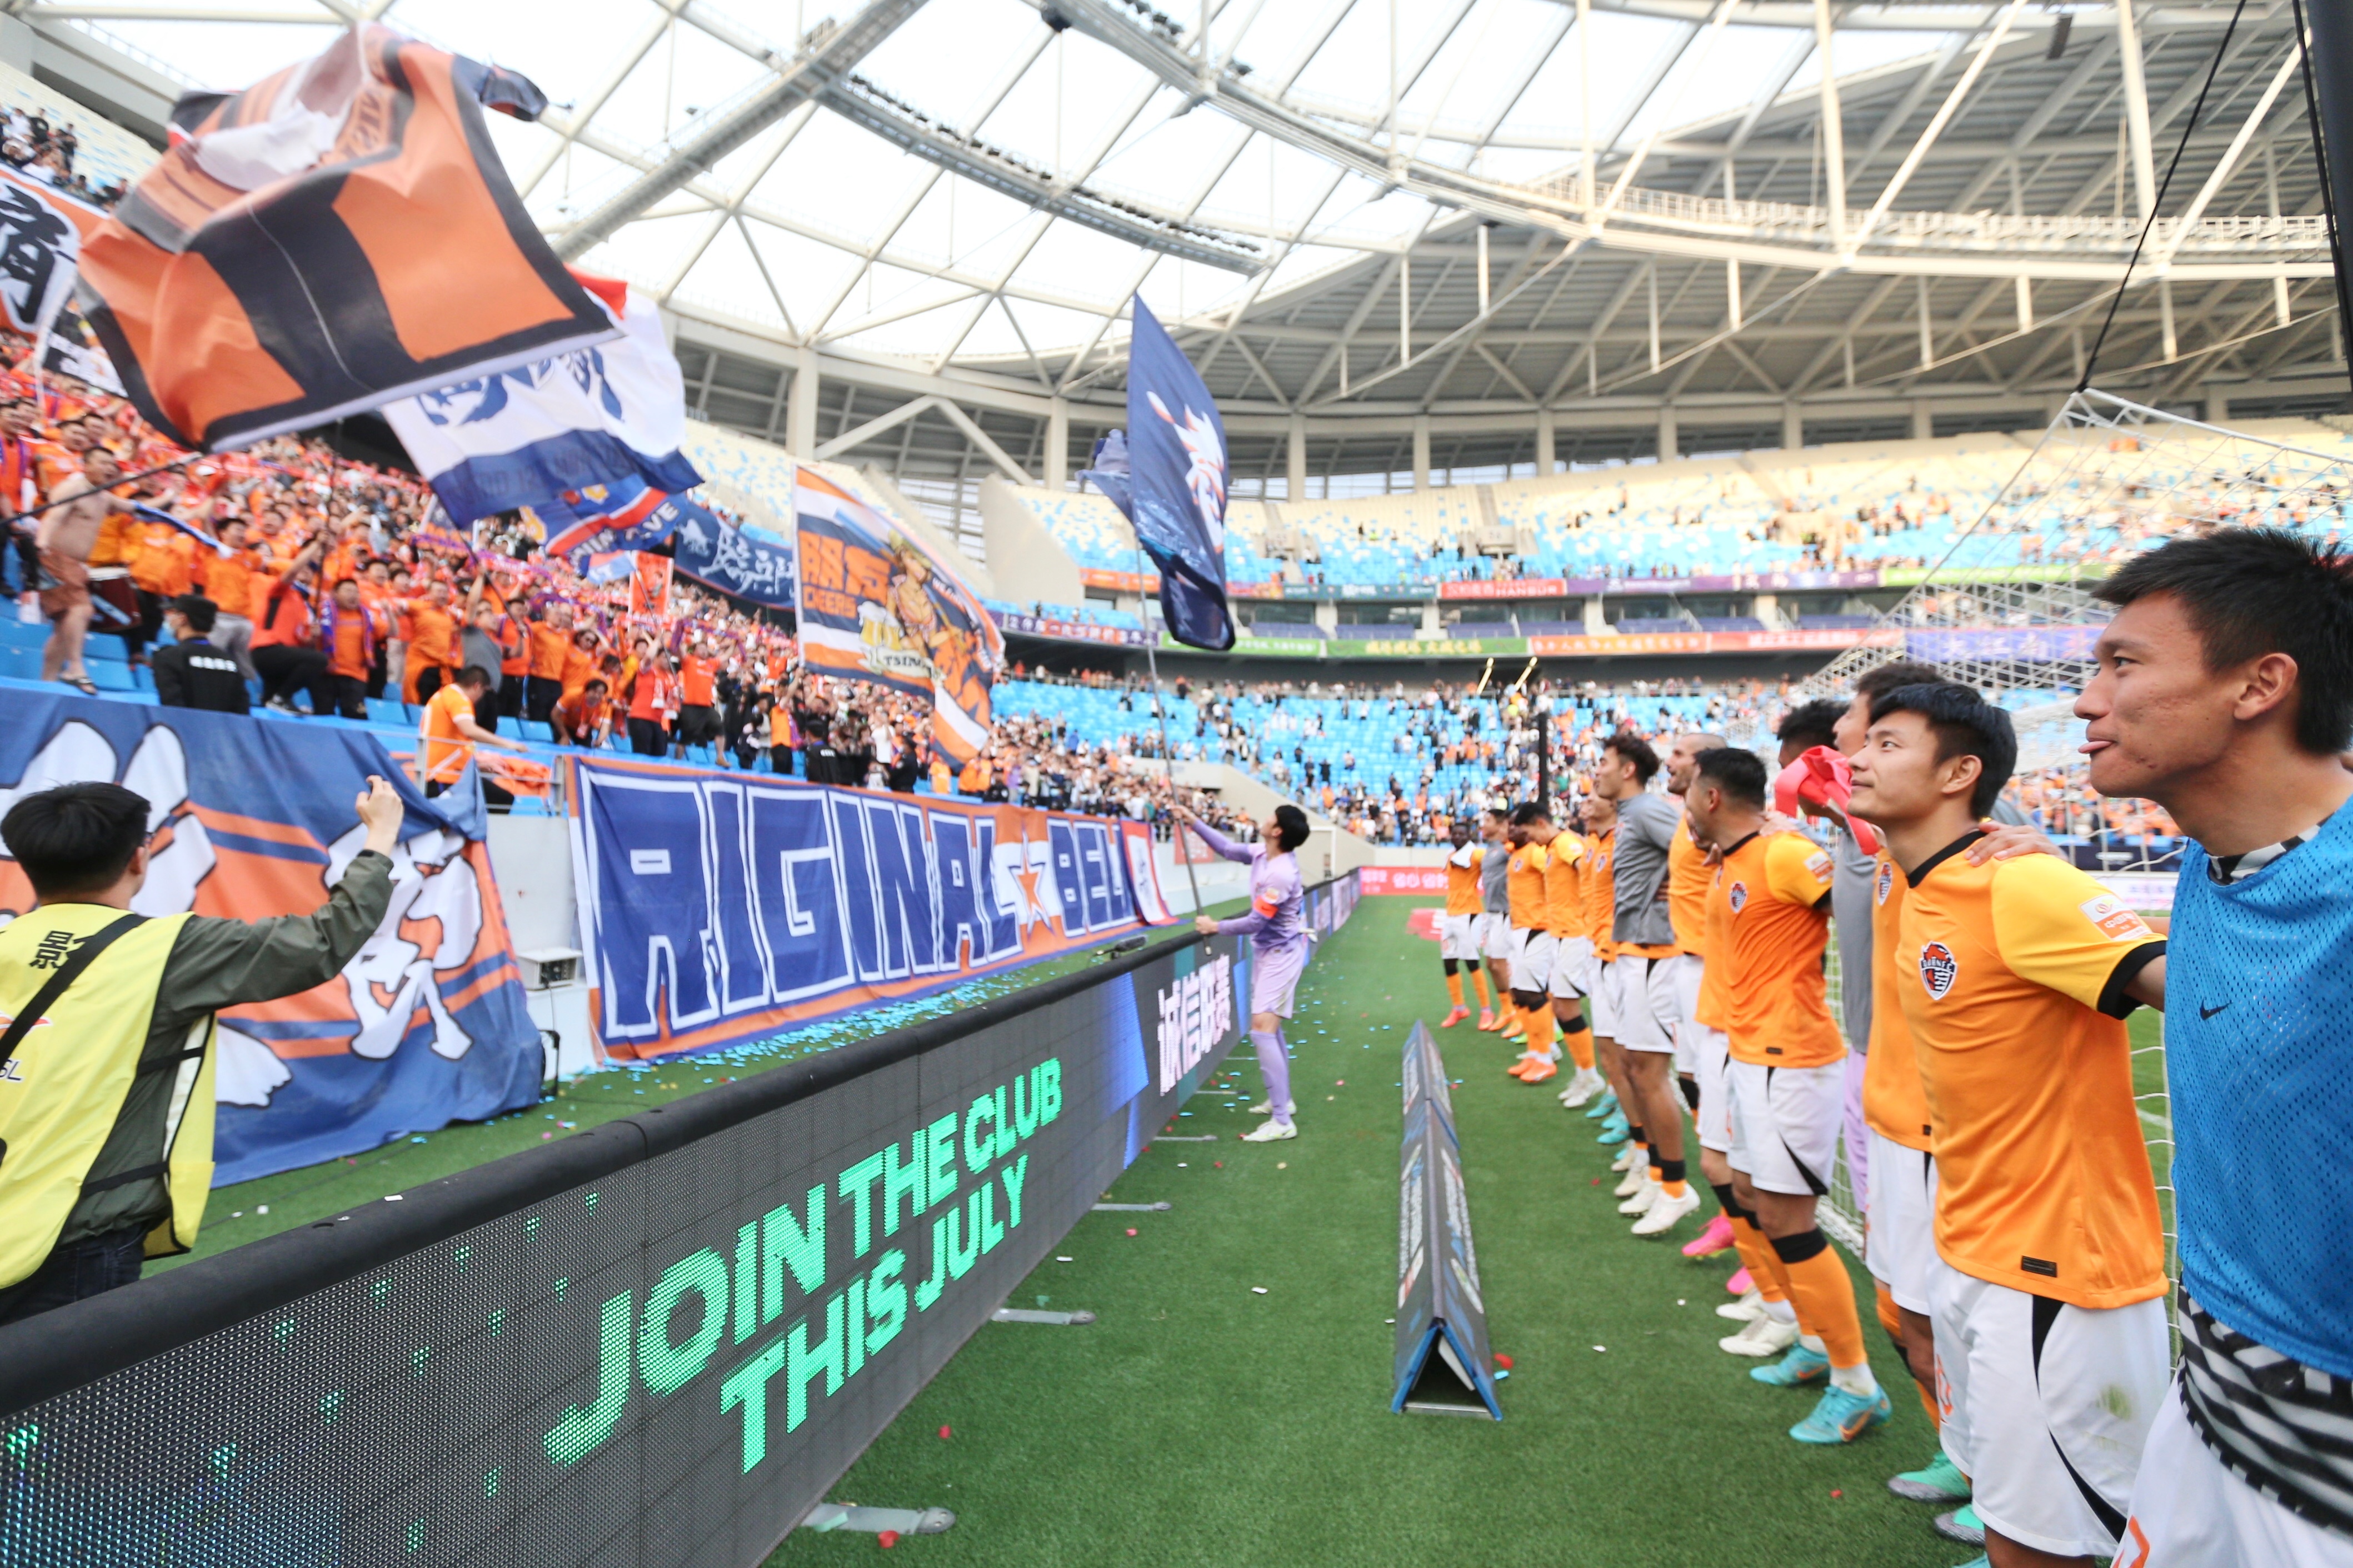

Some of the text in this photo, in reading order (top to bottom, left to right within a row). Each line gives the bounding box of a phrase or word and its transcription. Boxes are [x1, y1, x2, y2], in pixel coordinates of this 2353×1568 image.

[803, 585, 857, 619] CHEERS
[883, 654, 925, 668] TSIN
[1157, 953, 1231, 1096] 诚信联赛
[542, 1057, 1062, 1467] JOIN THE CLUB
[720, 1152, 1029, 1475] THIS JULY
